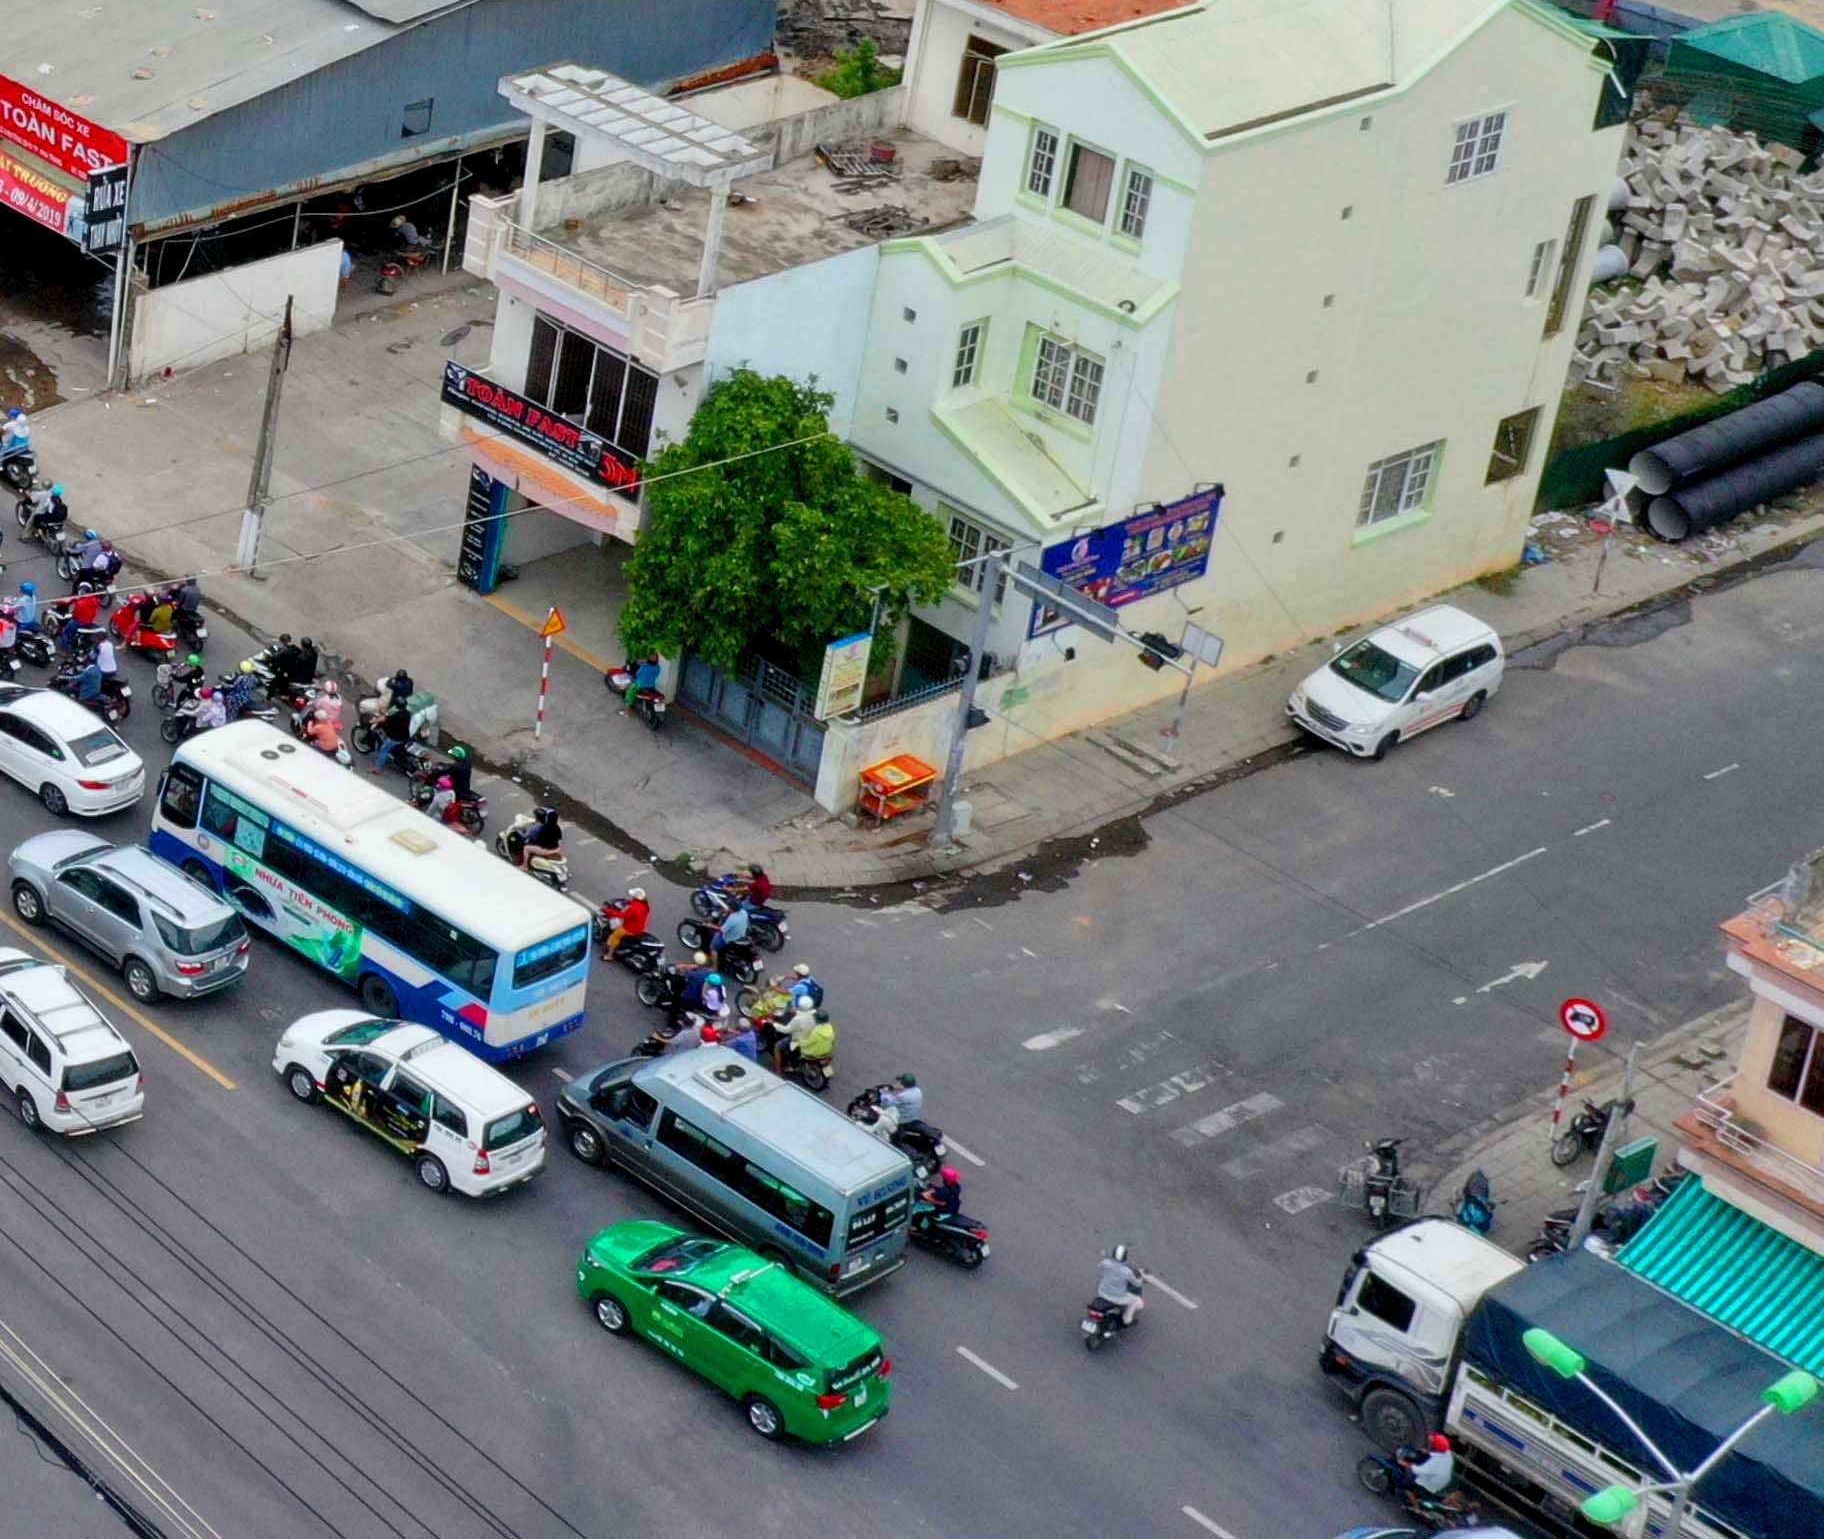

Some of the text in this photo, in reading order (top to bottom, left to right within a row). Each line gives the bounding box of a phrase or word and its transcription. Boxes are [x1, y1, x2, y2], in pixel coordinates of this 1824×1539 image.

[0, 98, 56, 145] TOÀN
[61, 132, 113, 169] FAST
[76, 120, 91, 138] XE
[112, 180, 126, 207] XE
[465, 376, 524, 420] TOÀN
[526, 406, 582, 448] FAST
[316, 905, 355, 934] PHONG
